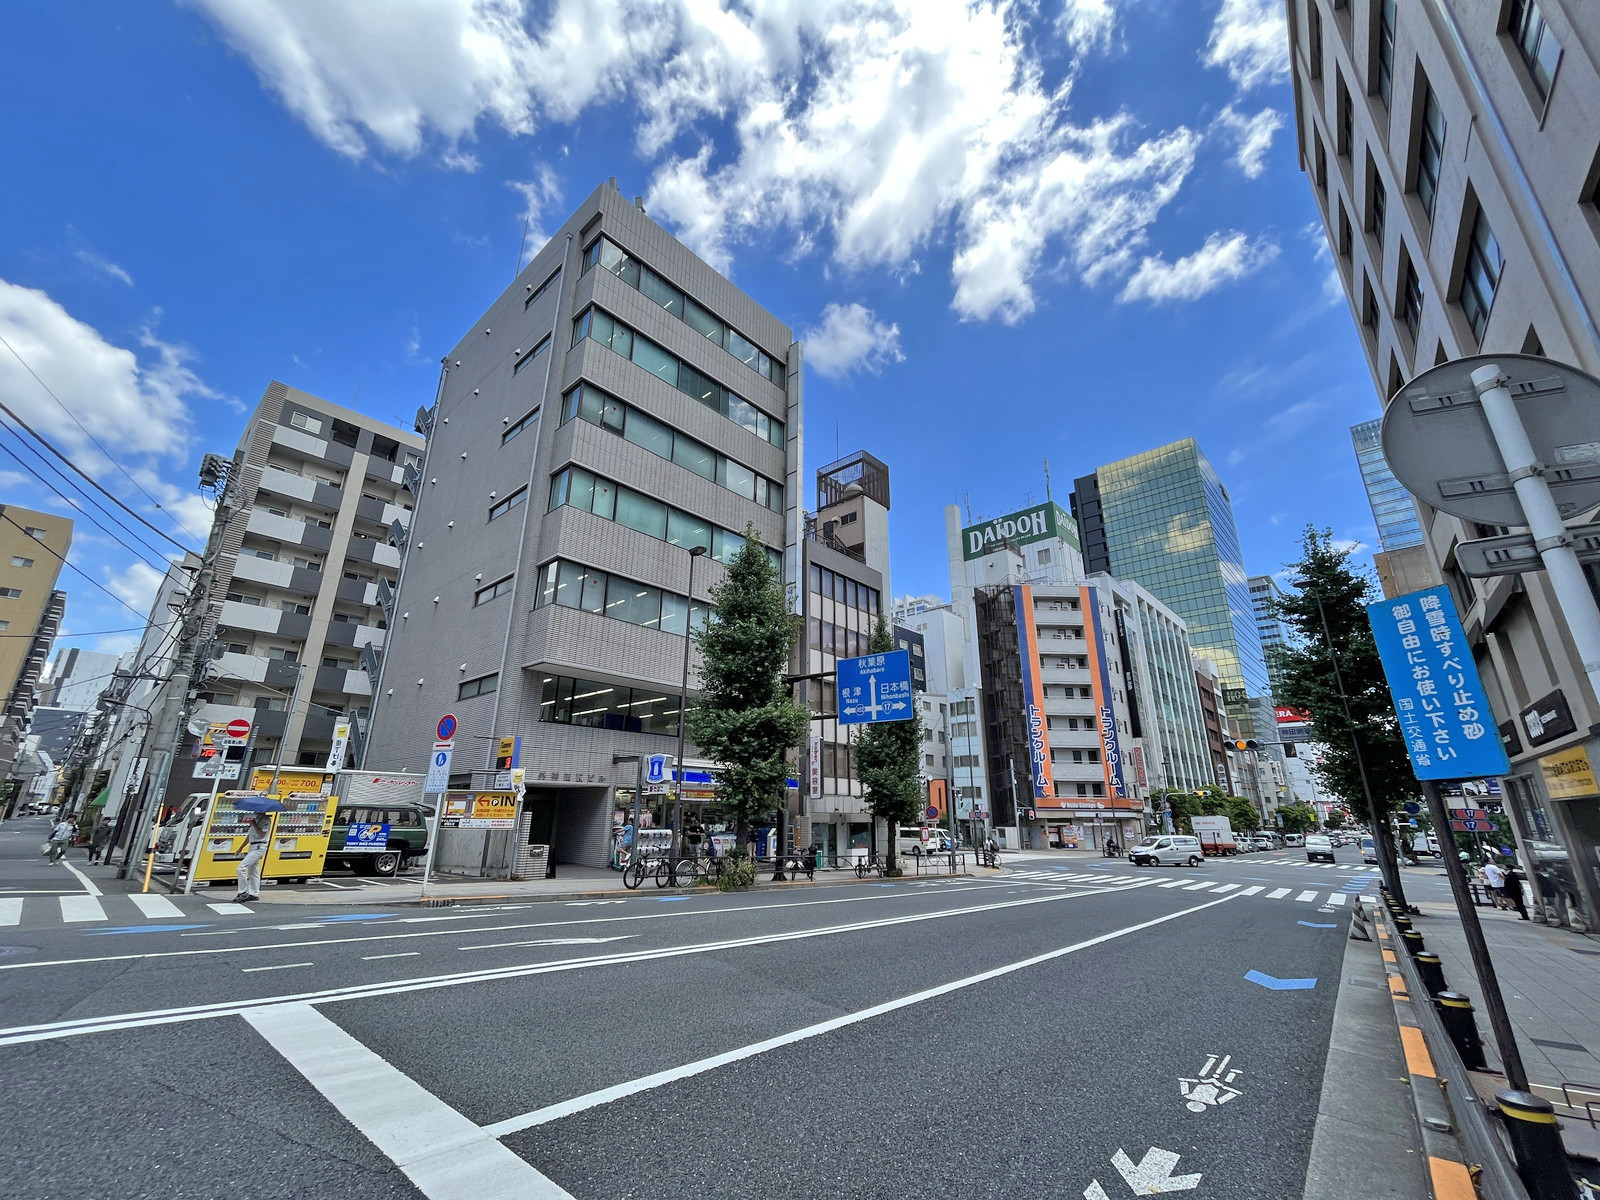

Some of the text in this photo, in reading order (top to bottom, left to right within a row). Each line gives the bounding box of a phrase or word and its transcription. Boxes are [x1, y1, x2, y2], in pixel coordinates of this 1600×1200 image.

[858, 656, 885, 668] 秋葉原
[1419, 595, 1485, 740] 降雪時すべり止め砂
[860, 667, 885, 675] Akihabara
[881, 681, 909, 693] 日本橋
[1392, 604, 1457, 761] 御自由にお使い下さい
[842, 686, 861, 698] 根津
[881, 692, 909, 700] Nihonbashi
[1399, 698, 1431, 766] 国土交通省
[1029, 705, 1049, 787] トランクルーム
[1100, 706, 1122, 788] トランクルーム
[501, 796, 515, 807] IN
[1466, 809, 1474, 817] 17
